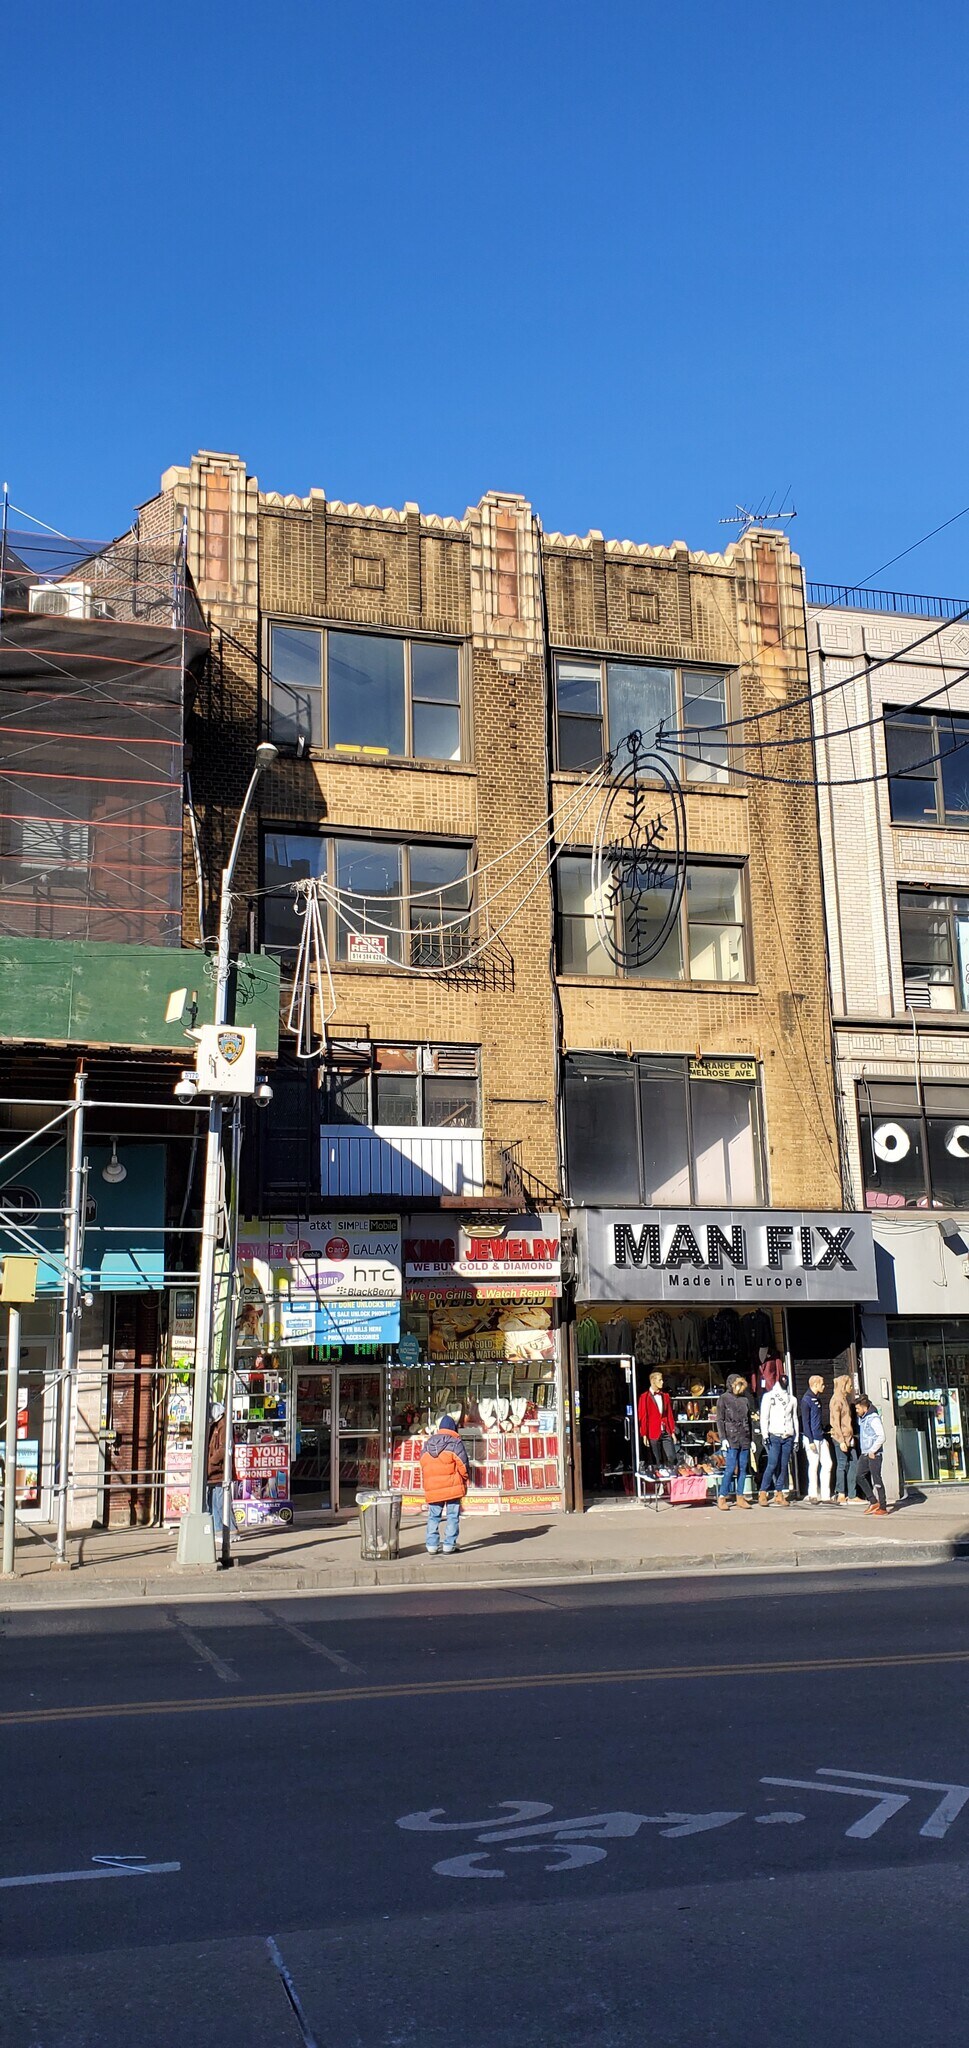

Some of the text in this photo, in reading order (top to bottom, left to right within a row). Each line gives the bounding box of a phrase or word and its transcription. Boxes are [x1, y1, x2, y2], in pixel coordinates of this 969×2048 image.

[355, 937, 380, 945] FOR
[351, 943, 383, 953] RENT
[690, 1062, 735, 1070] ENTRANCE
[690, 1069, 730, 1077] MELROSE
[309, 1220, 397, 1231] at&t SIMPLE Mobile
[353, 1243, 399, 1255] GALAXY
[403, 1238, 559, 1261] KING JEWELRY
[613, 1223, 856, 1269] MAN FIX
[413, 1263, 430, 1271] WE
[433, 1263, 454, 1271] BUY
[459, 1263, 488, 1271] GOLD
[503, 1262, 553, 1270] DIAMOND
[301, 1276, 339, 1285] SAMSUNG
[669, 1275, 803, 1290] Made in Europe
[347, 1287, 396, 1297] BlackBerry
[411, 1287, 552, 1301] We Do Grills & Watch Repair
[339, 1301, 356, 1309] DONE
[447, 1341, 459, 1350] WE
[459, 1341, 474, 1349] BUY
[475, 1350, 509, 1359] WATCHES
[896, 1389, 941, 1400] conecta
[256, 1446, 286, 1457] YOUR
[253, 1457, 286, 1467] HERE!
[240, 1470, 272, 1478] PHONES
[537, 1495, 560, 1503] Diamonds
